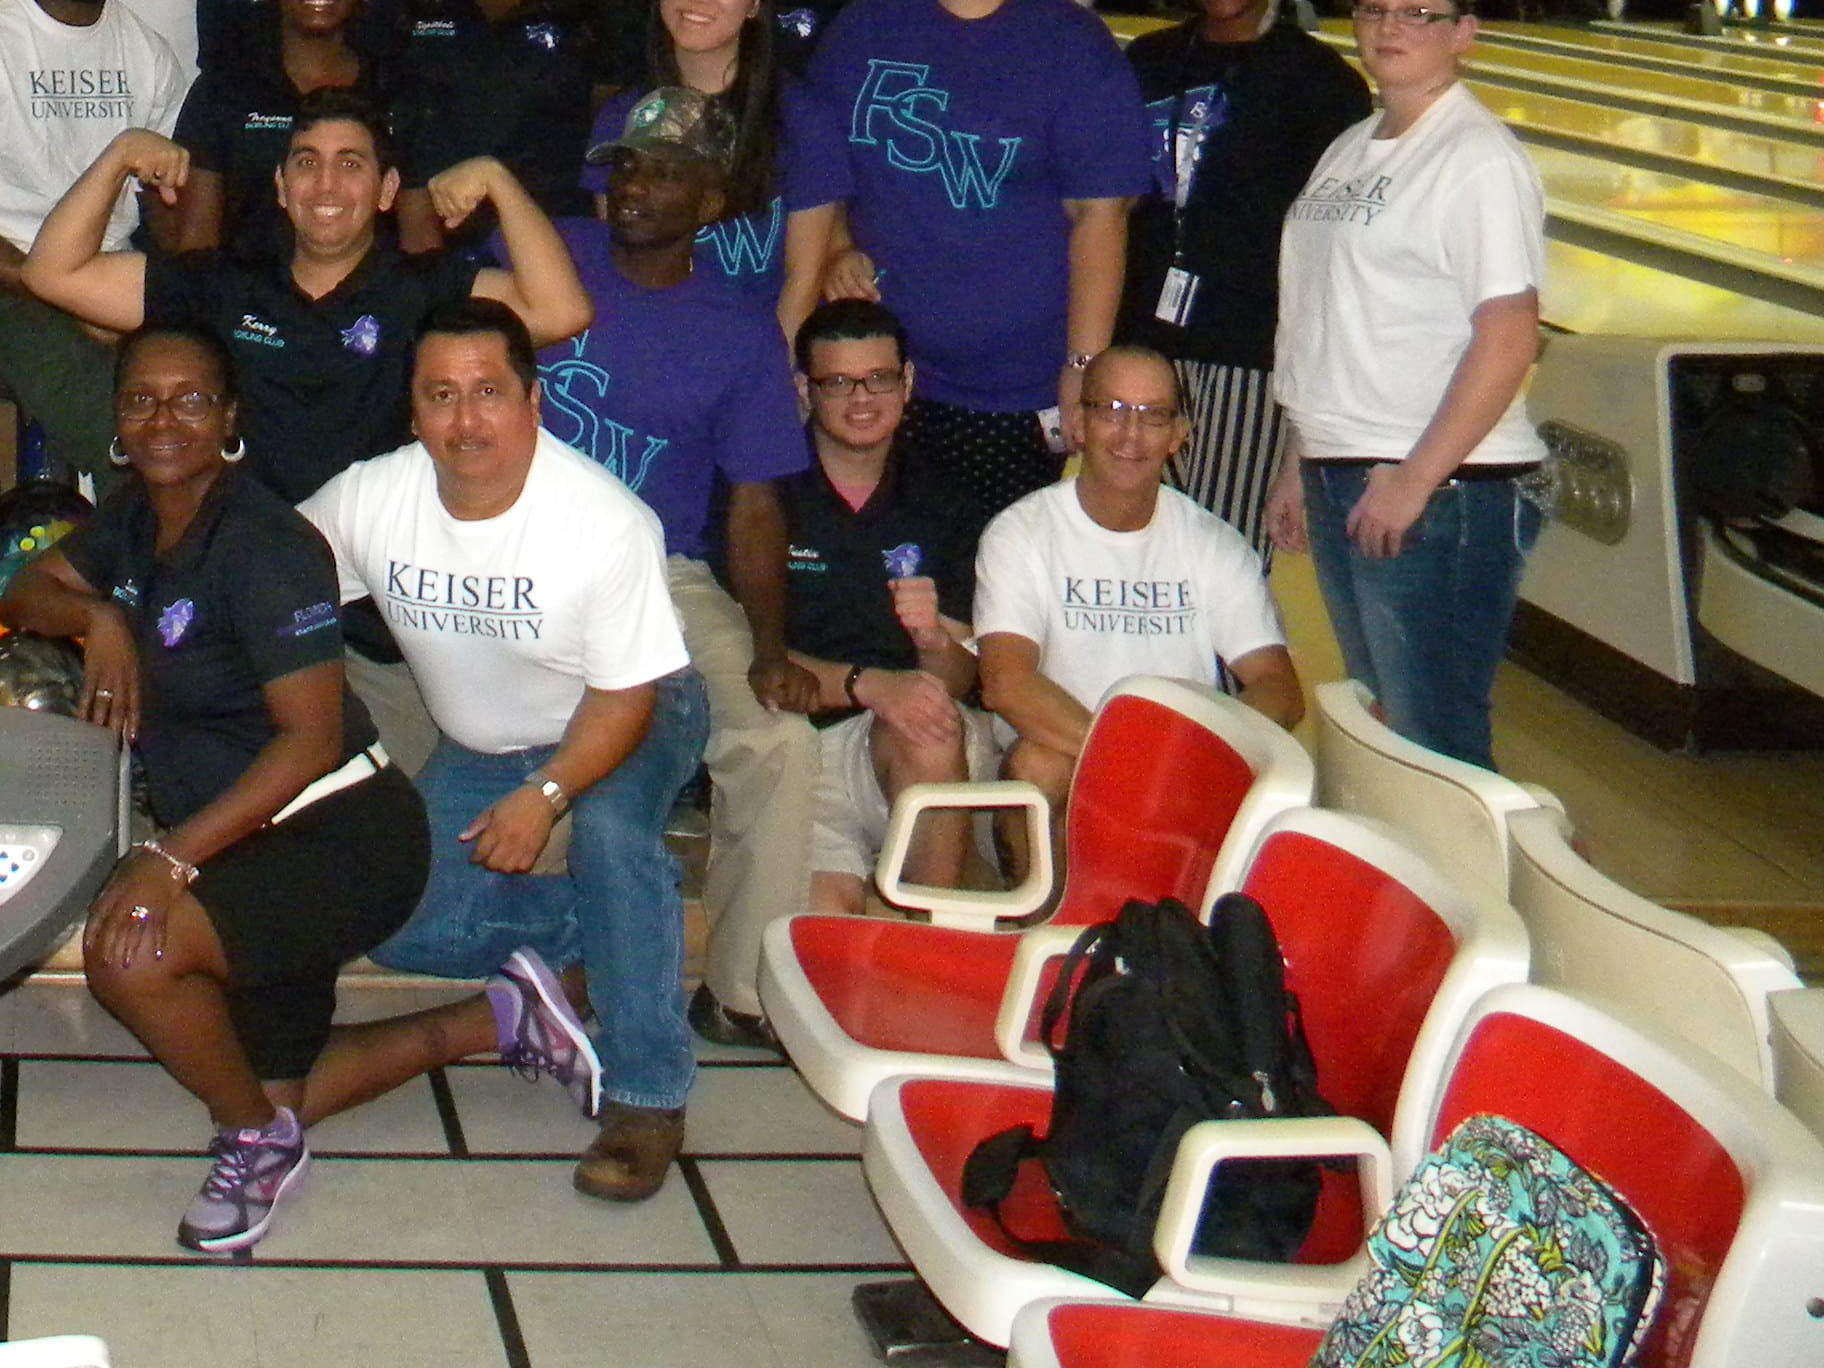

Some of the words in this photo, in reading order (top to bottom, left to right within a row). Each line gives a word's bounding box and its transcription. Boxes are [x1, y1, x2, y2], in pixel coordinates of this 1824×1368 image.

[31, 100, 136, 120] UNIVERSITY
[848, 59, 1023, 209] FSW
[387, 560, 540, 611] KEISER
[386, 600, 544, 640] UNIVERSITY
